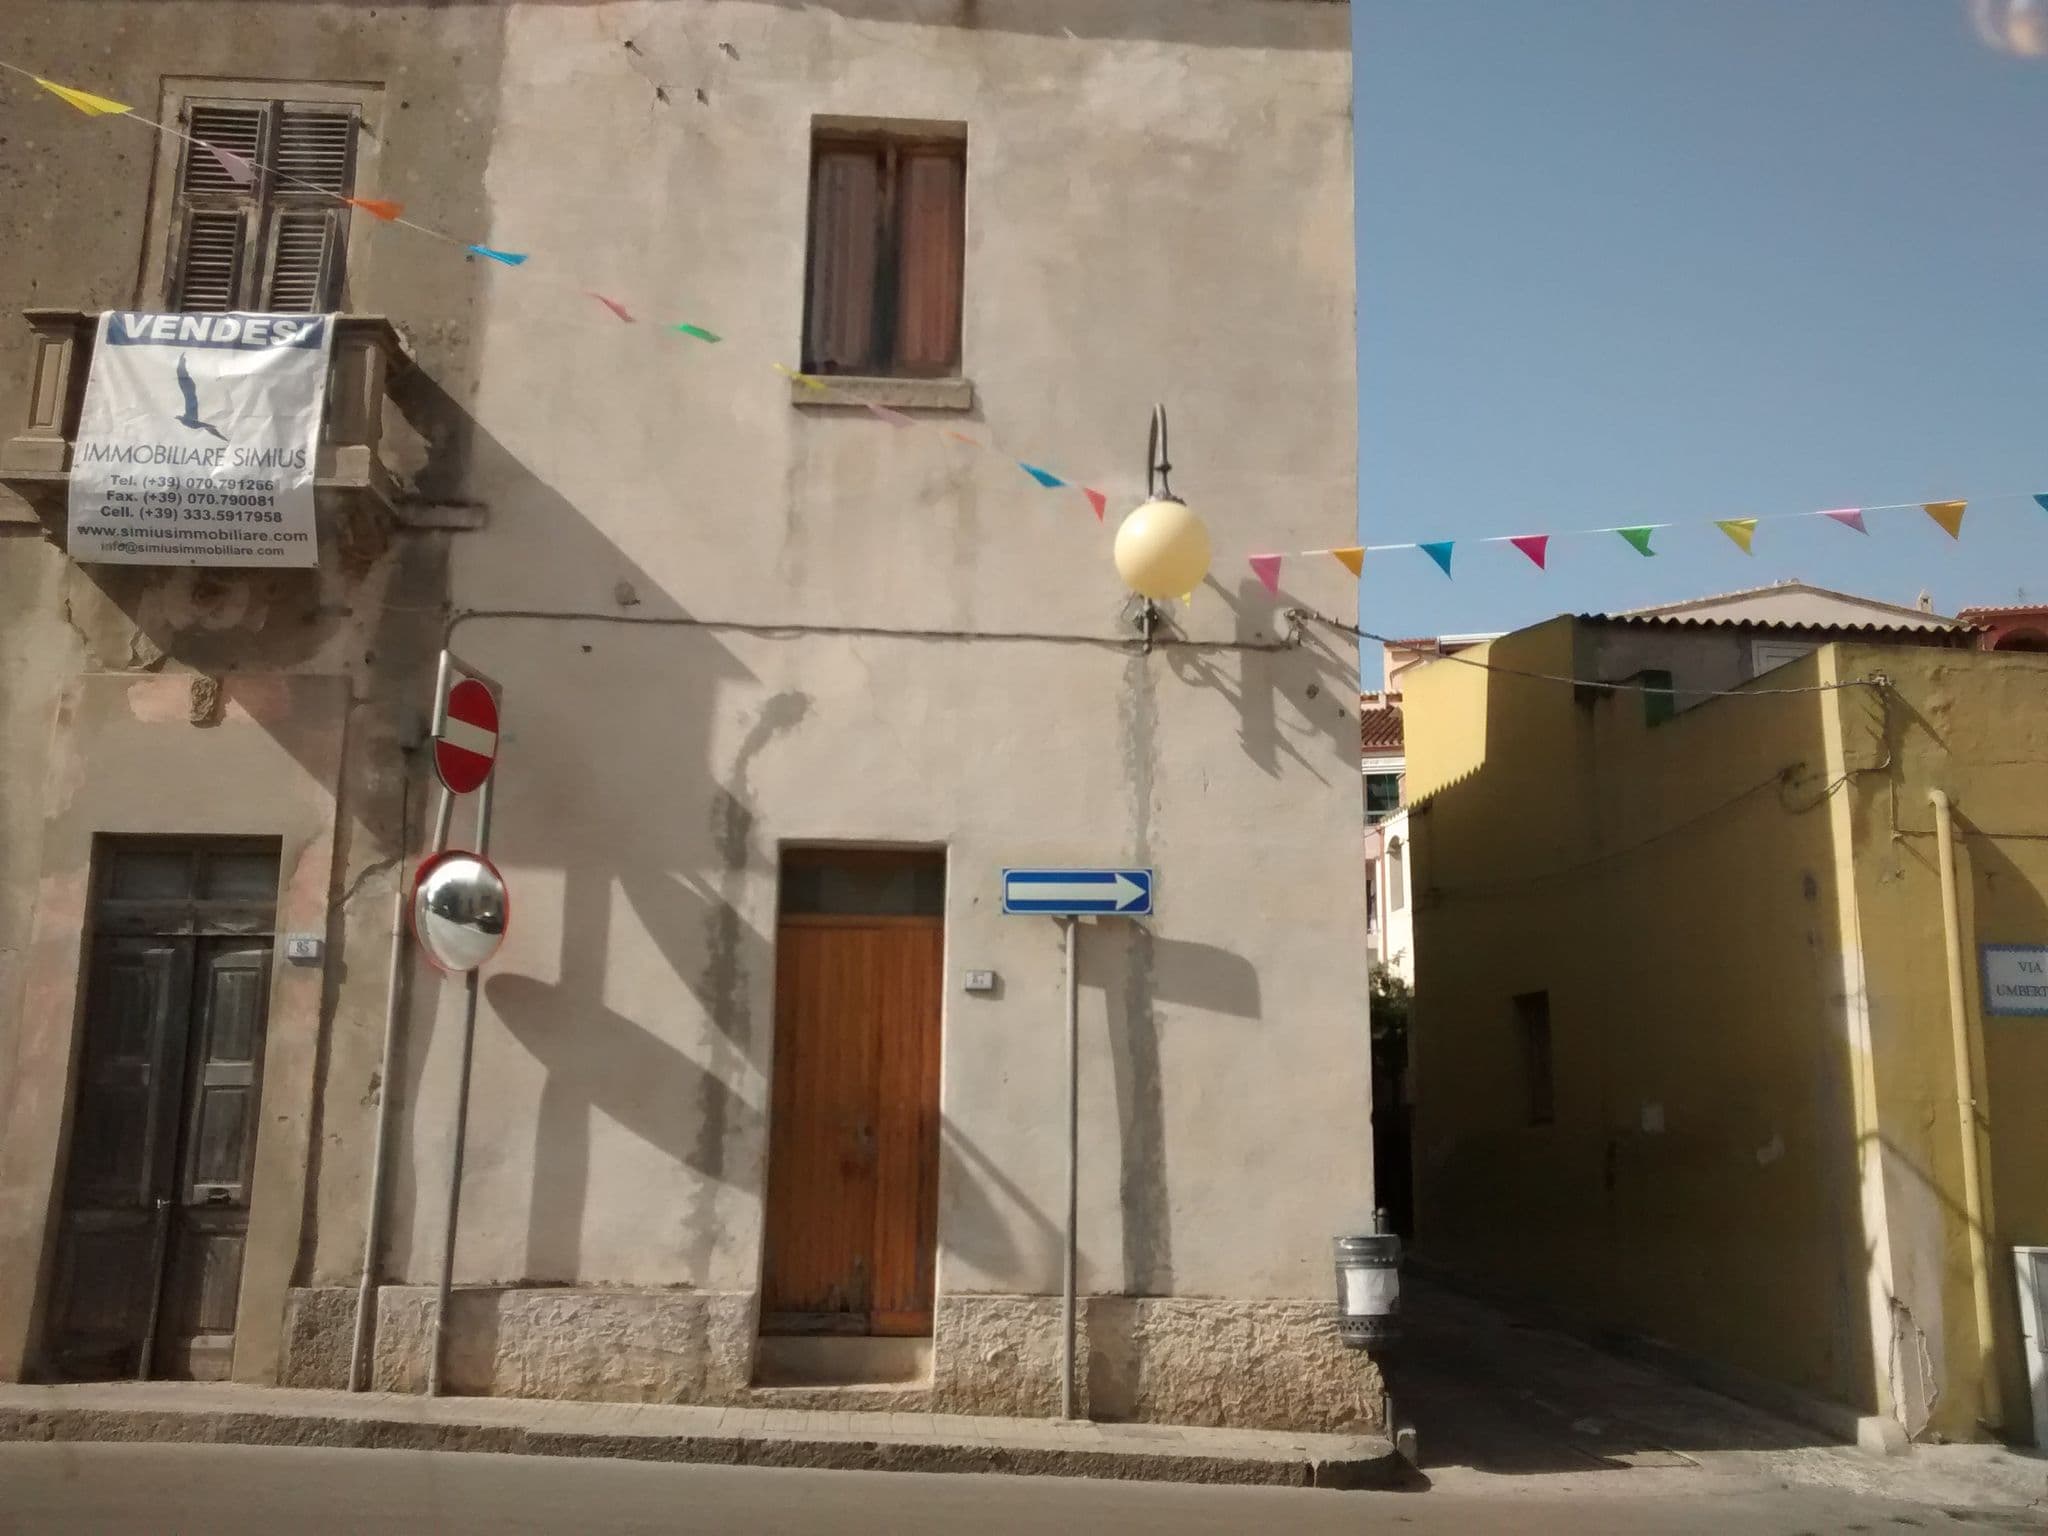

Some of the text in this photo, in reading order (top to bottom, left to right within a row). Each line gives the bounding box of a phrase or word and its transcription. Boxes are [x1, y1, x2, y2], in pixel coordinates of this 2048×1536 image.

[83, 442, 306, 469] IMMOBILIARE SIMIUS
[110, 474, 137, 487] Tel.
[142, 476, 180, 490] (+39)
[106, 490, 275, 507] Fax. (+39) 070.790081
[100, 505, 283, 523] Cell. (+39) 333.5917958
[77, 525, 309, 542] www.simiusimmobiliare.com
[101, 540, 285, 556] info@simiusimmobiliare.com
[2017, 961, 2043, 973] VIA
